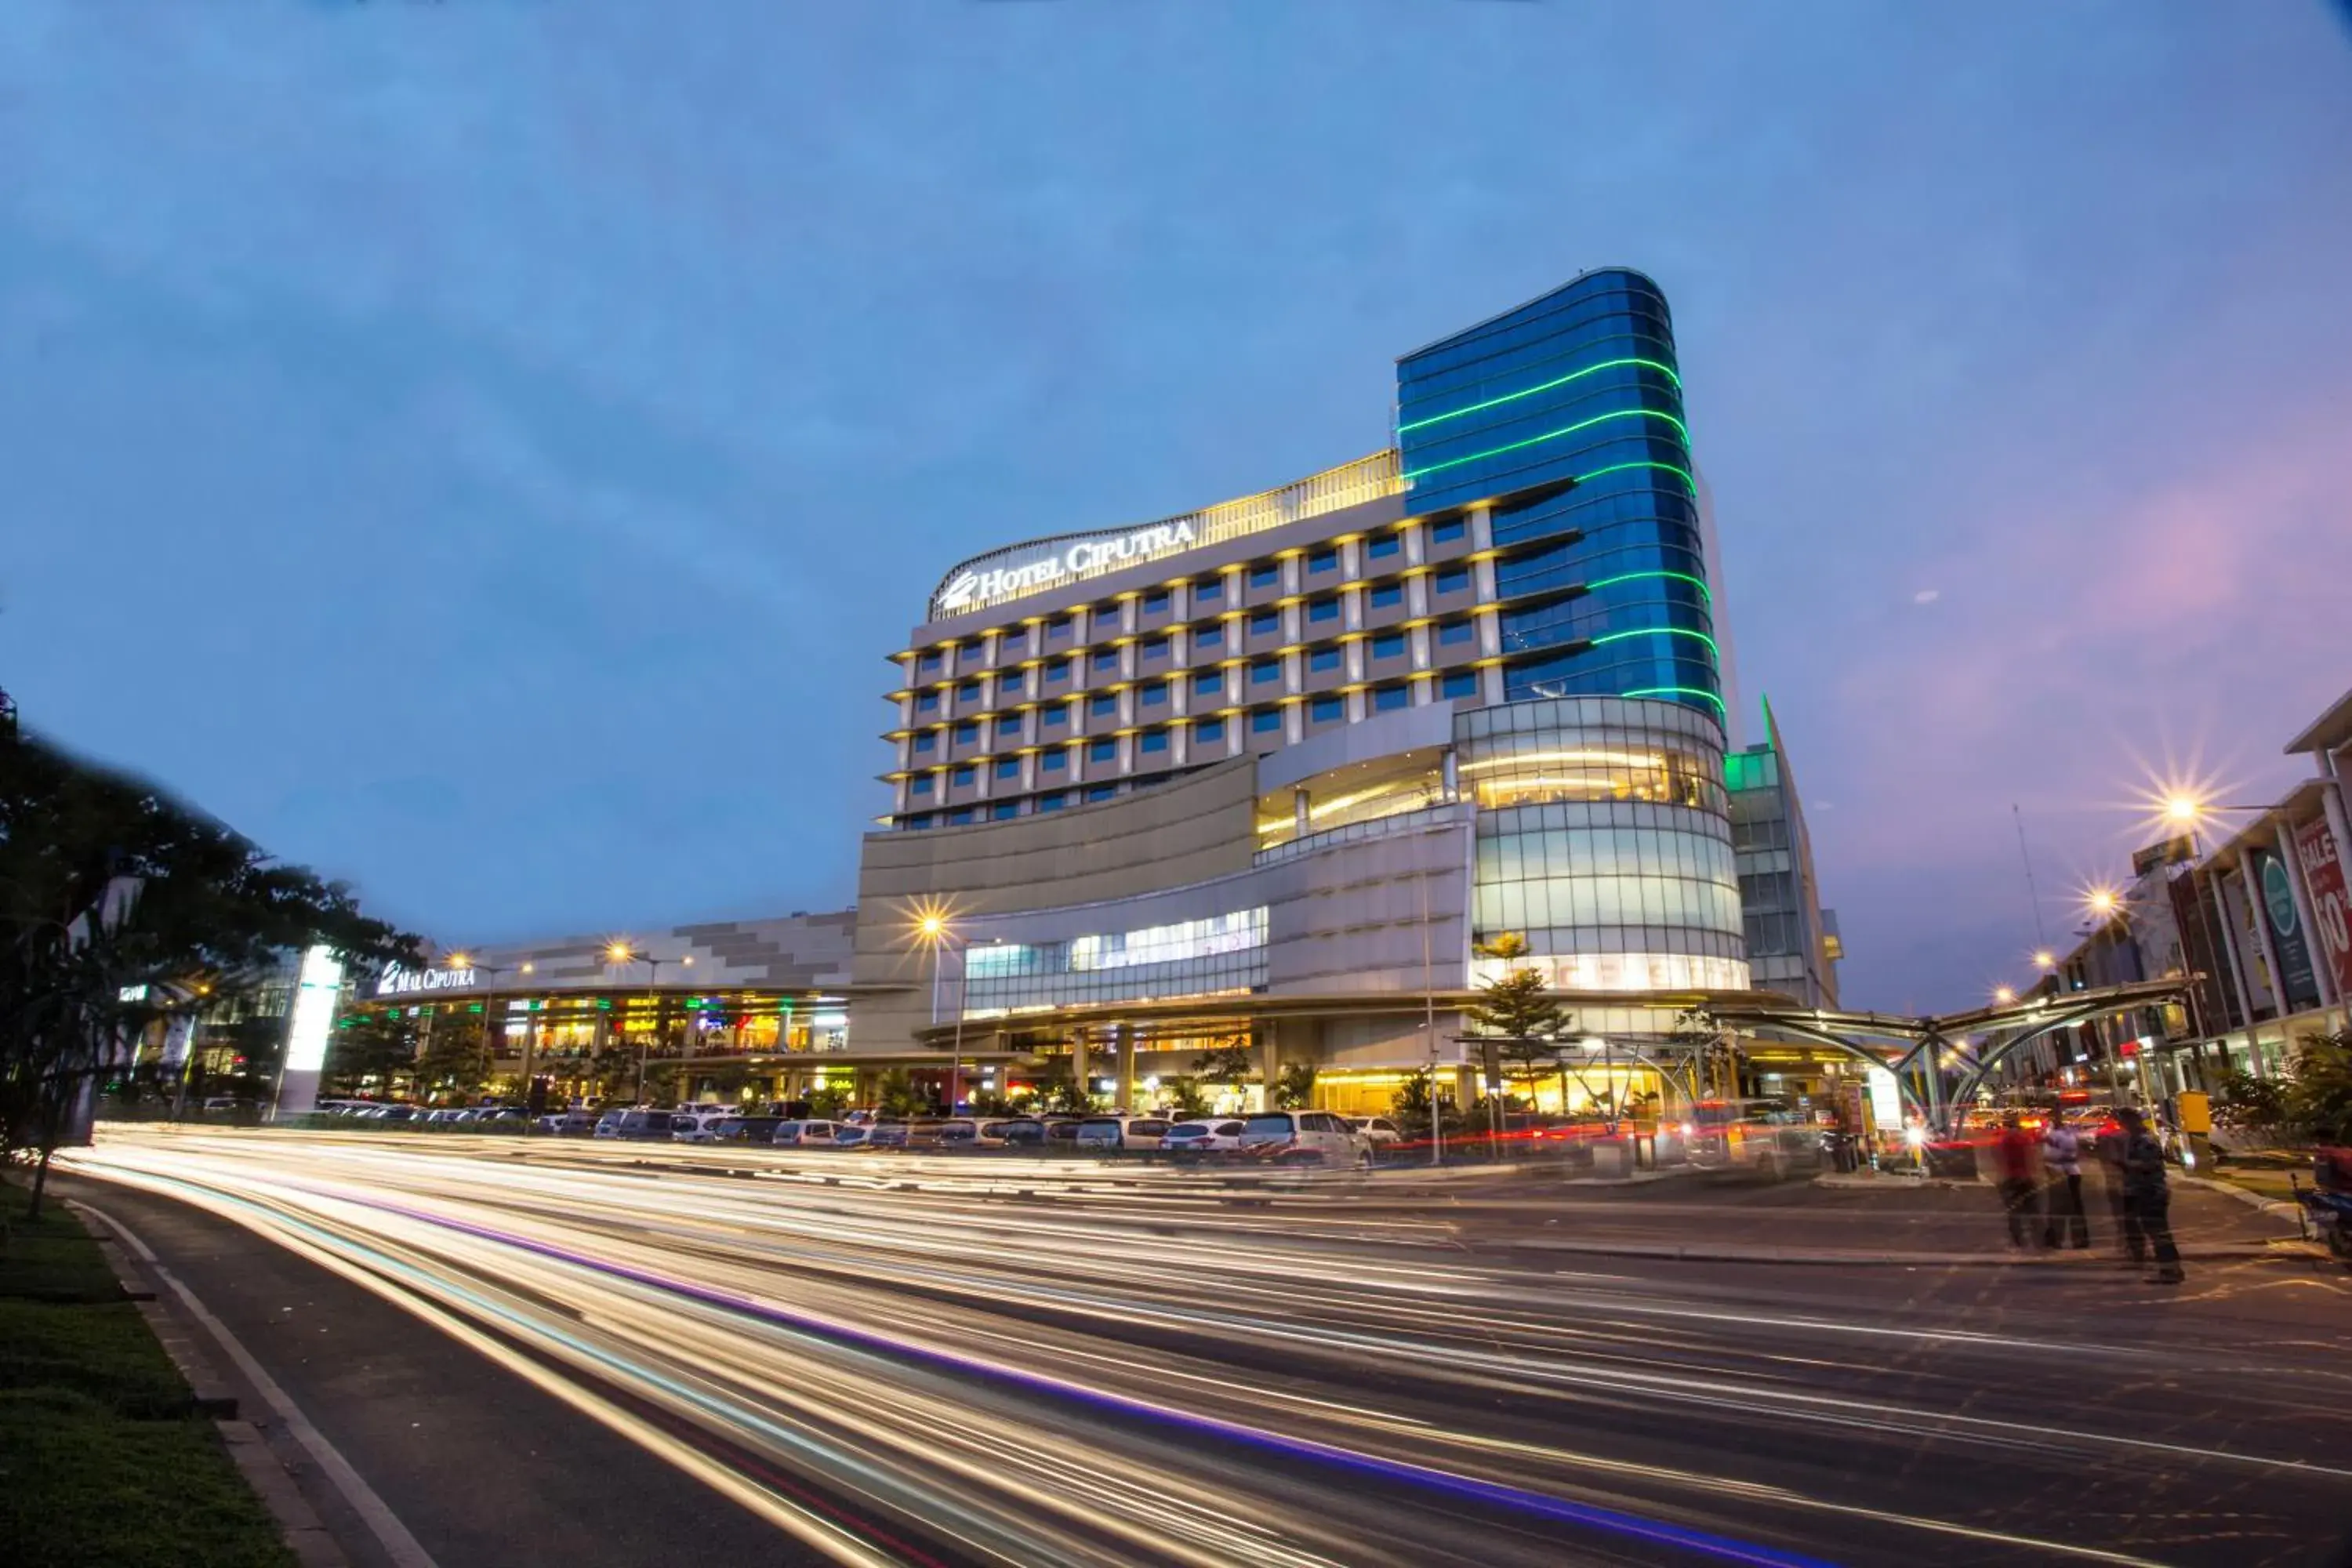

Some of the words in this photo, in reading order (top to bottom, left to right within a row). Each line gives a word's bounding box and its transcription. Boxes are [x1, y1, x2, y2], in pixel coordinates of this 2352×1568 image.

[978, 558, 1065, 599] HOTEL
[1066, 520, 1194, 572] CIPUTRA
[396, 971, 422, 992] MAL
[423, 968, 474, 989] CIPUTRA
